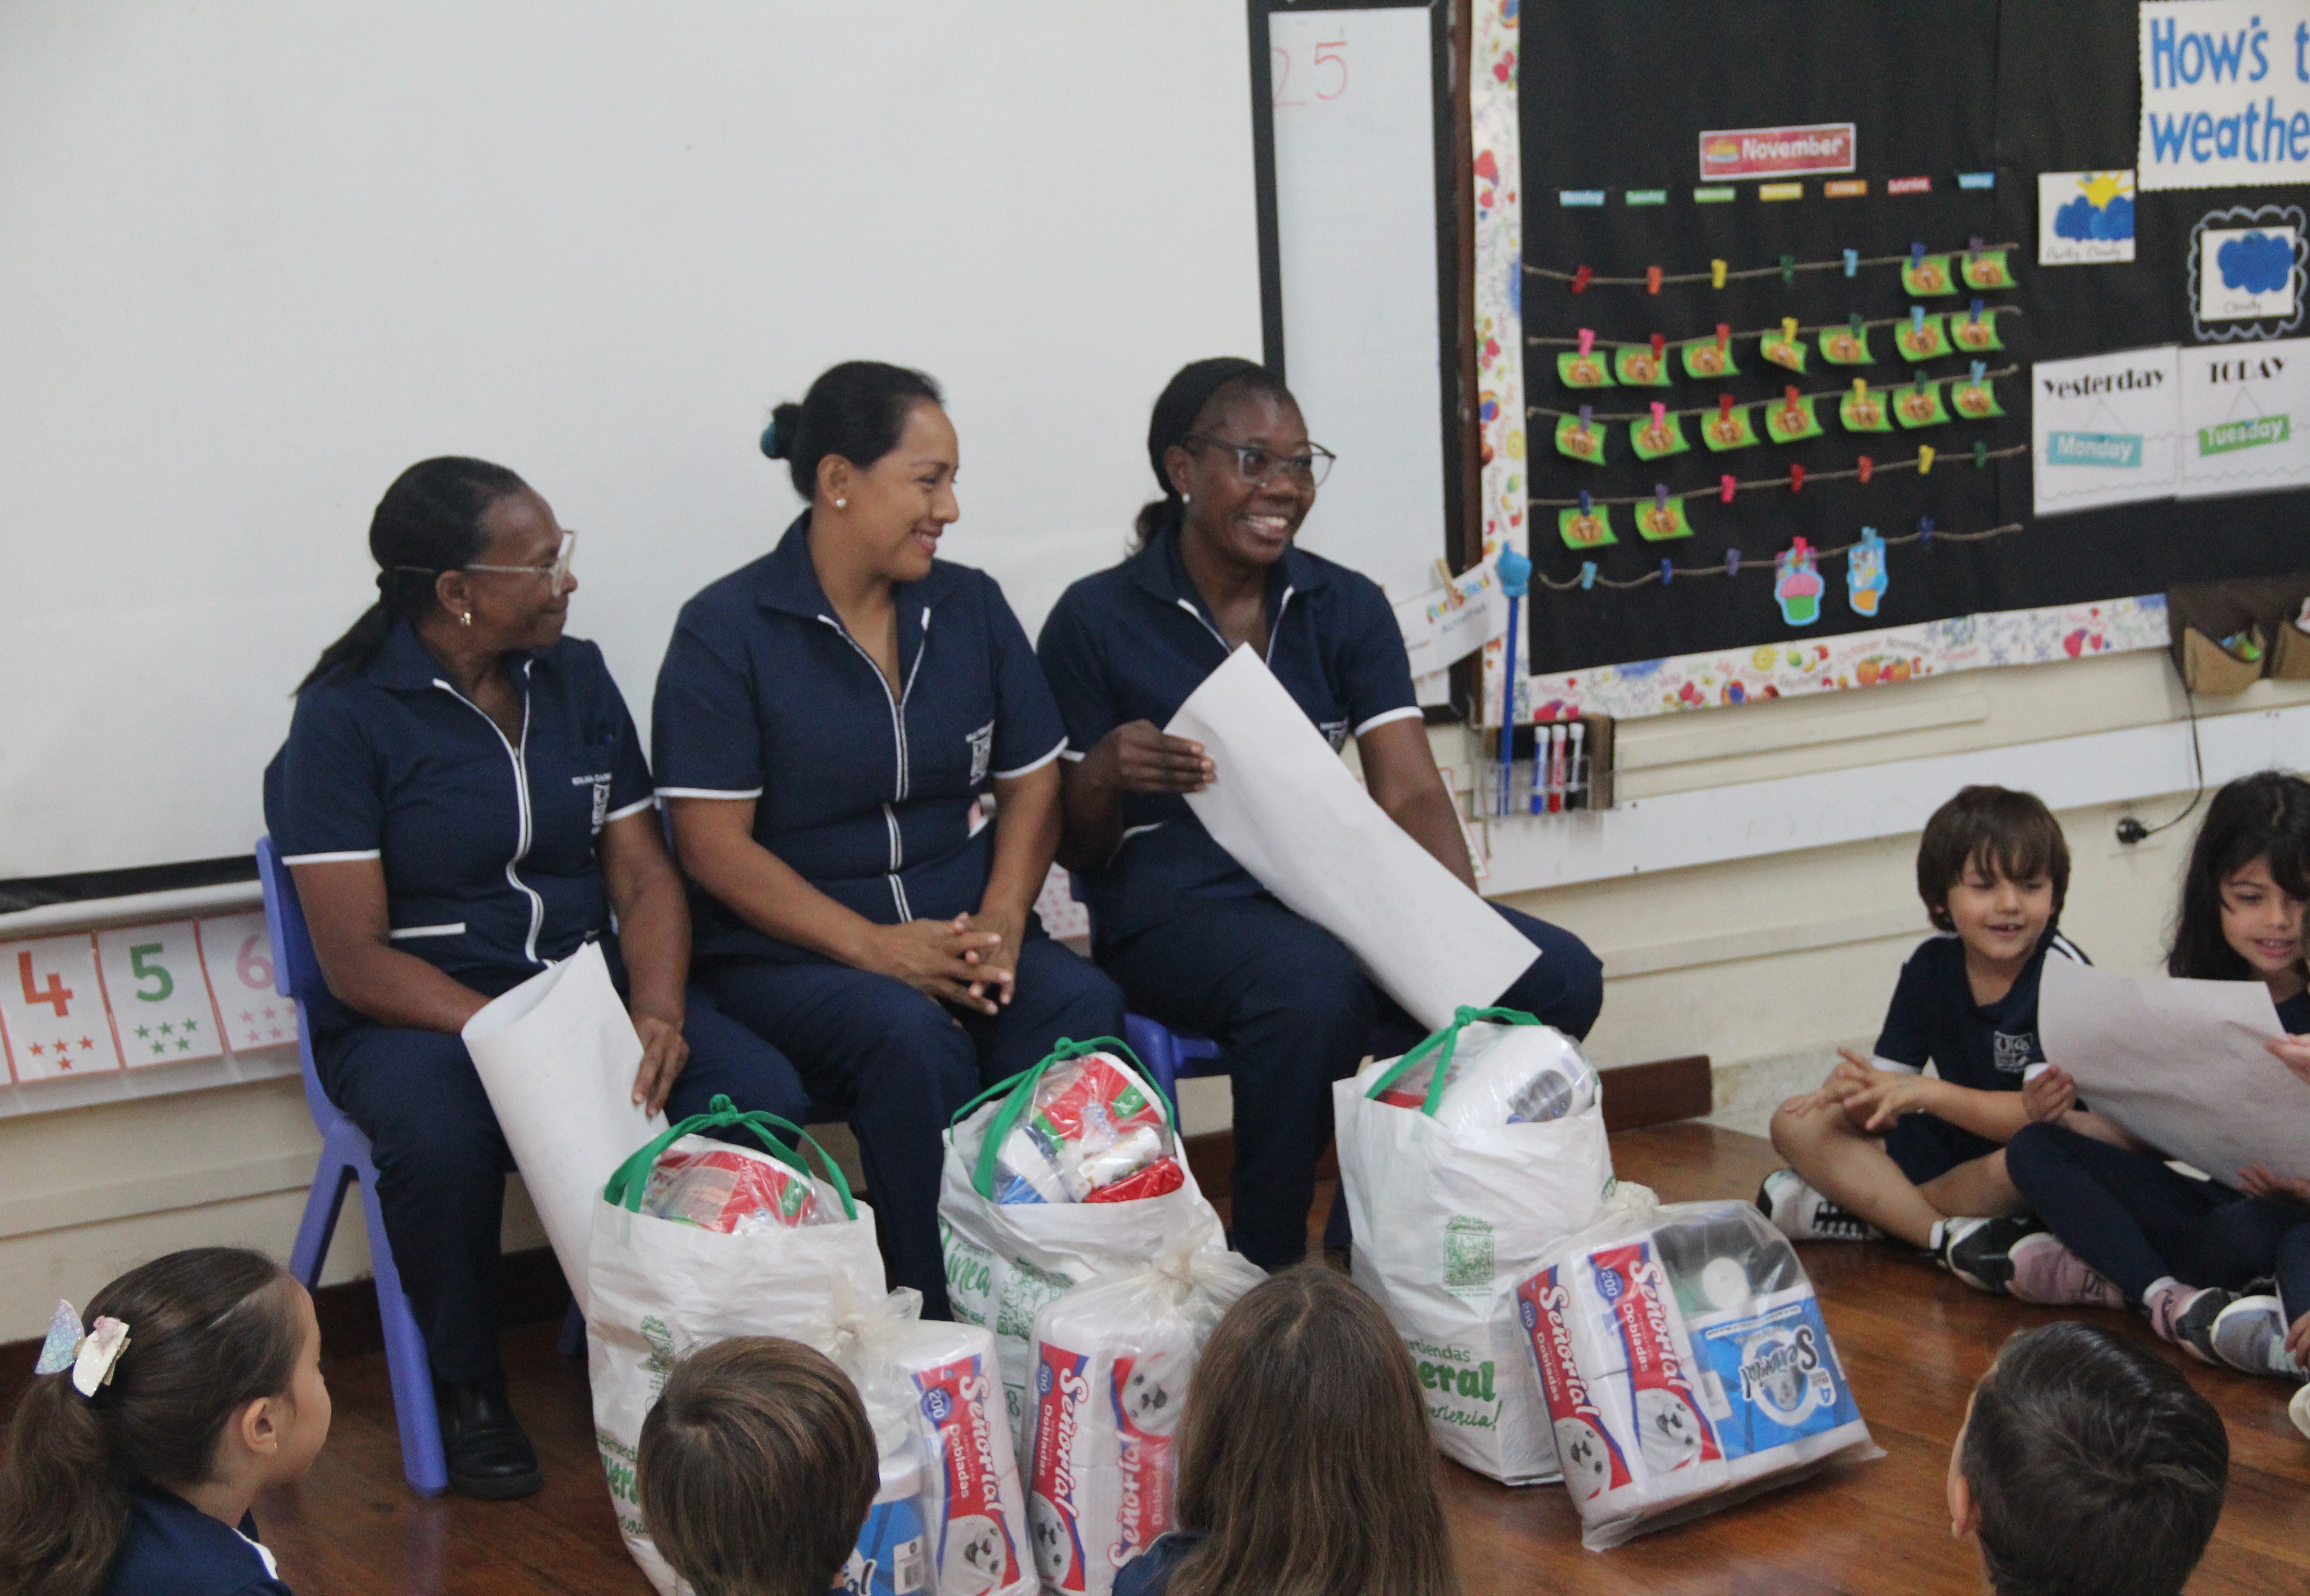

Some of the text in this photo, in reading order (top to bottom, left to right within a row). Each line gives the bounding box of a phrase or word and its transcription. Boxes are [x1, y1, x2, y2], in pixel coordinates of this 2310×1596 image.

[1271, 41, 1348, 107] 25
[2150, 16, 2269, 89] How's
[1742, 134, 1844, 160] November
[2149, 96, 2310, 163] weathe
[2043, 368, 2166, 399] Yesterday
[2209, 357, 2288, 384] TODAY
[2056, 435, 2134, 462] Monday
[2206, 419, 2285, 447] Tuesday
[17, 934, 275, 1018] 4 5 6
[1601, 1272, 1617, 1297] 200
[1622, 1303, 1650, 1372] Dobladas
[1417, 1360, 1496, 1402] eral
[1536, 1332, 1560, 1402] Dobladas
[928, 1390, 945, 1419] 200
[948, 1423, 970, 1499] Dobladas
[1039, 1403, 1053, 1477] Dobladas
